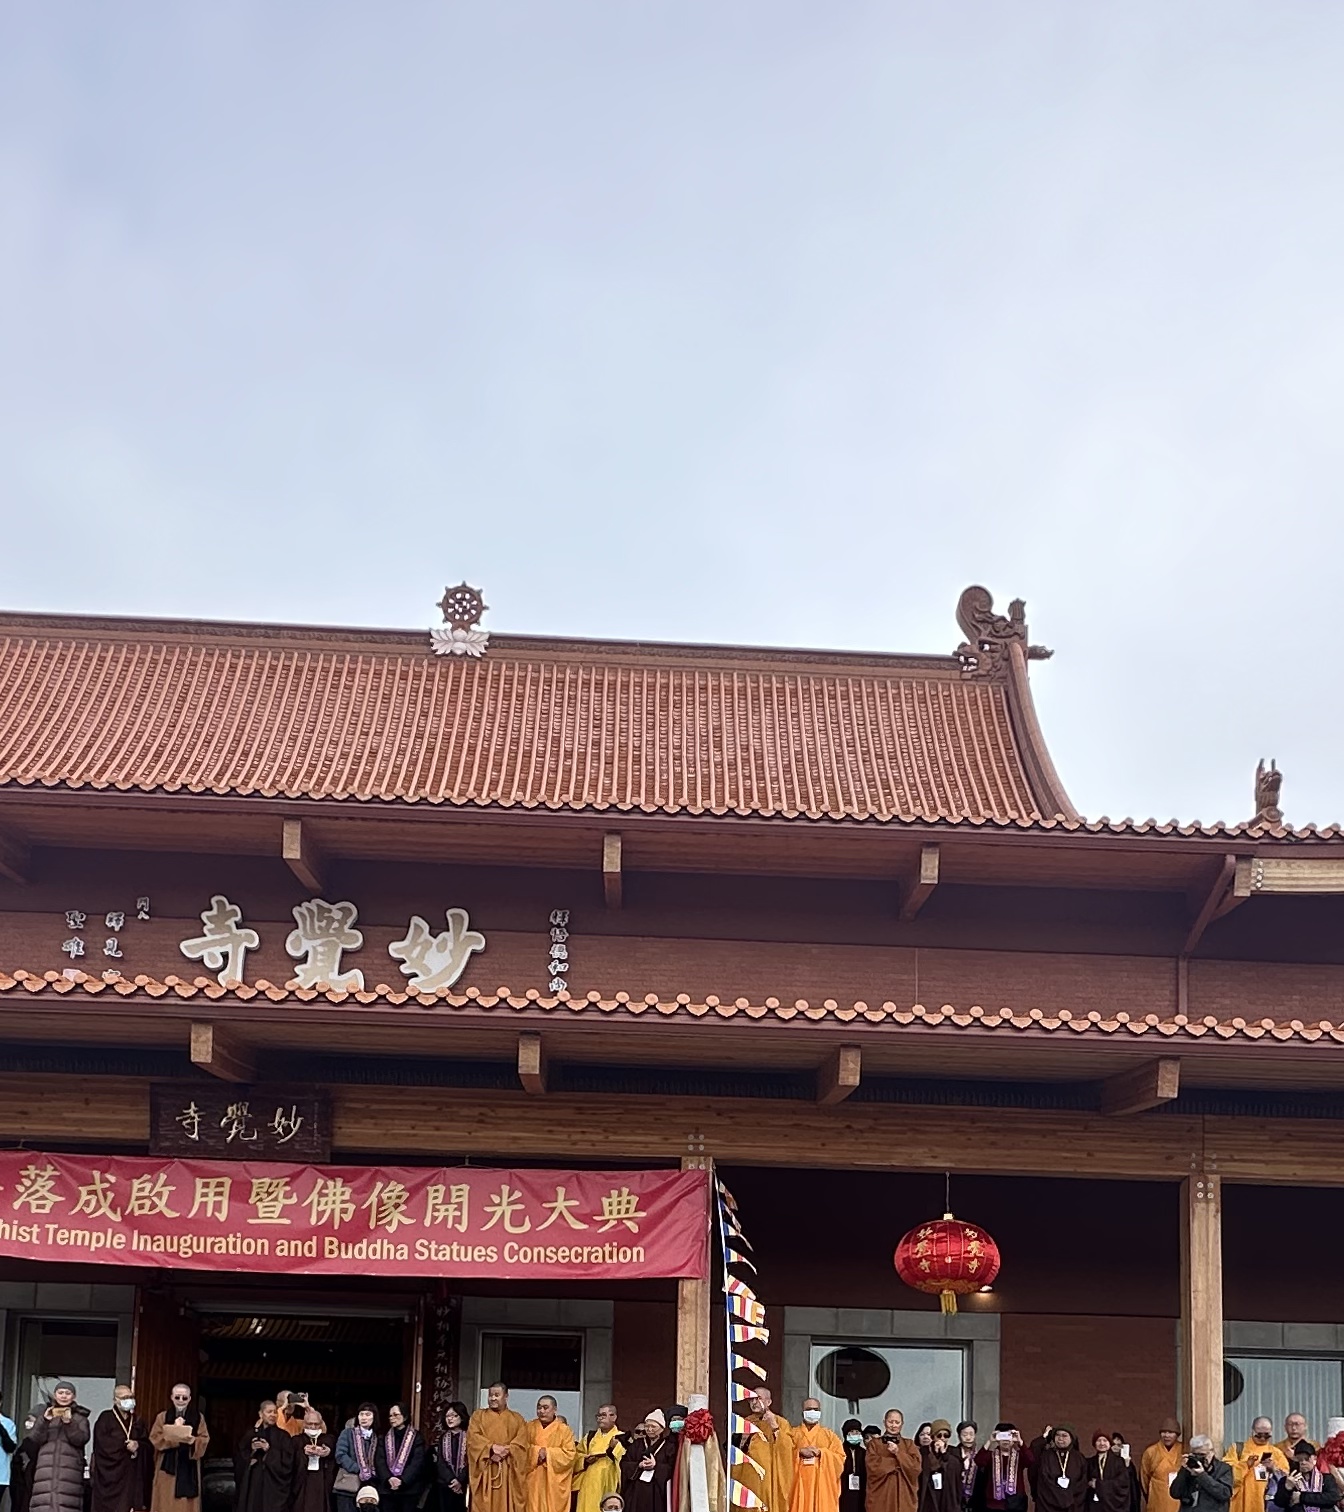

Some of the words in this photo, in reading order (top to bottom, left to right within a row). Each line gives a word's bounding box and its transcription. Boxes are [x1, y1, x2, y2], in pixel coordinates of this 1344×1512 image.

[45, 1223, 127, 1251] Temple
[131, 1229, 270, 1258] Inauguration
[275, 1235, 318, 1258] and
[324, 1236, 408, 1261] Buddha
[414, 1238, 498, 1263] Statues
[504, 1241, 645, 1265] Consecration
